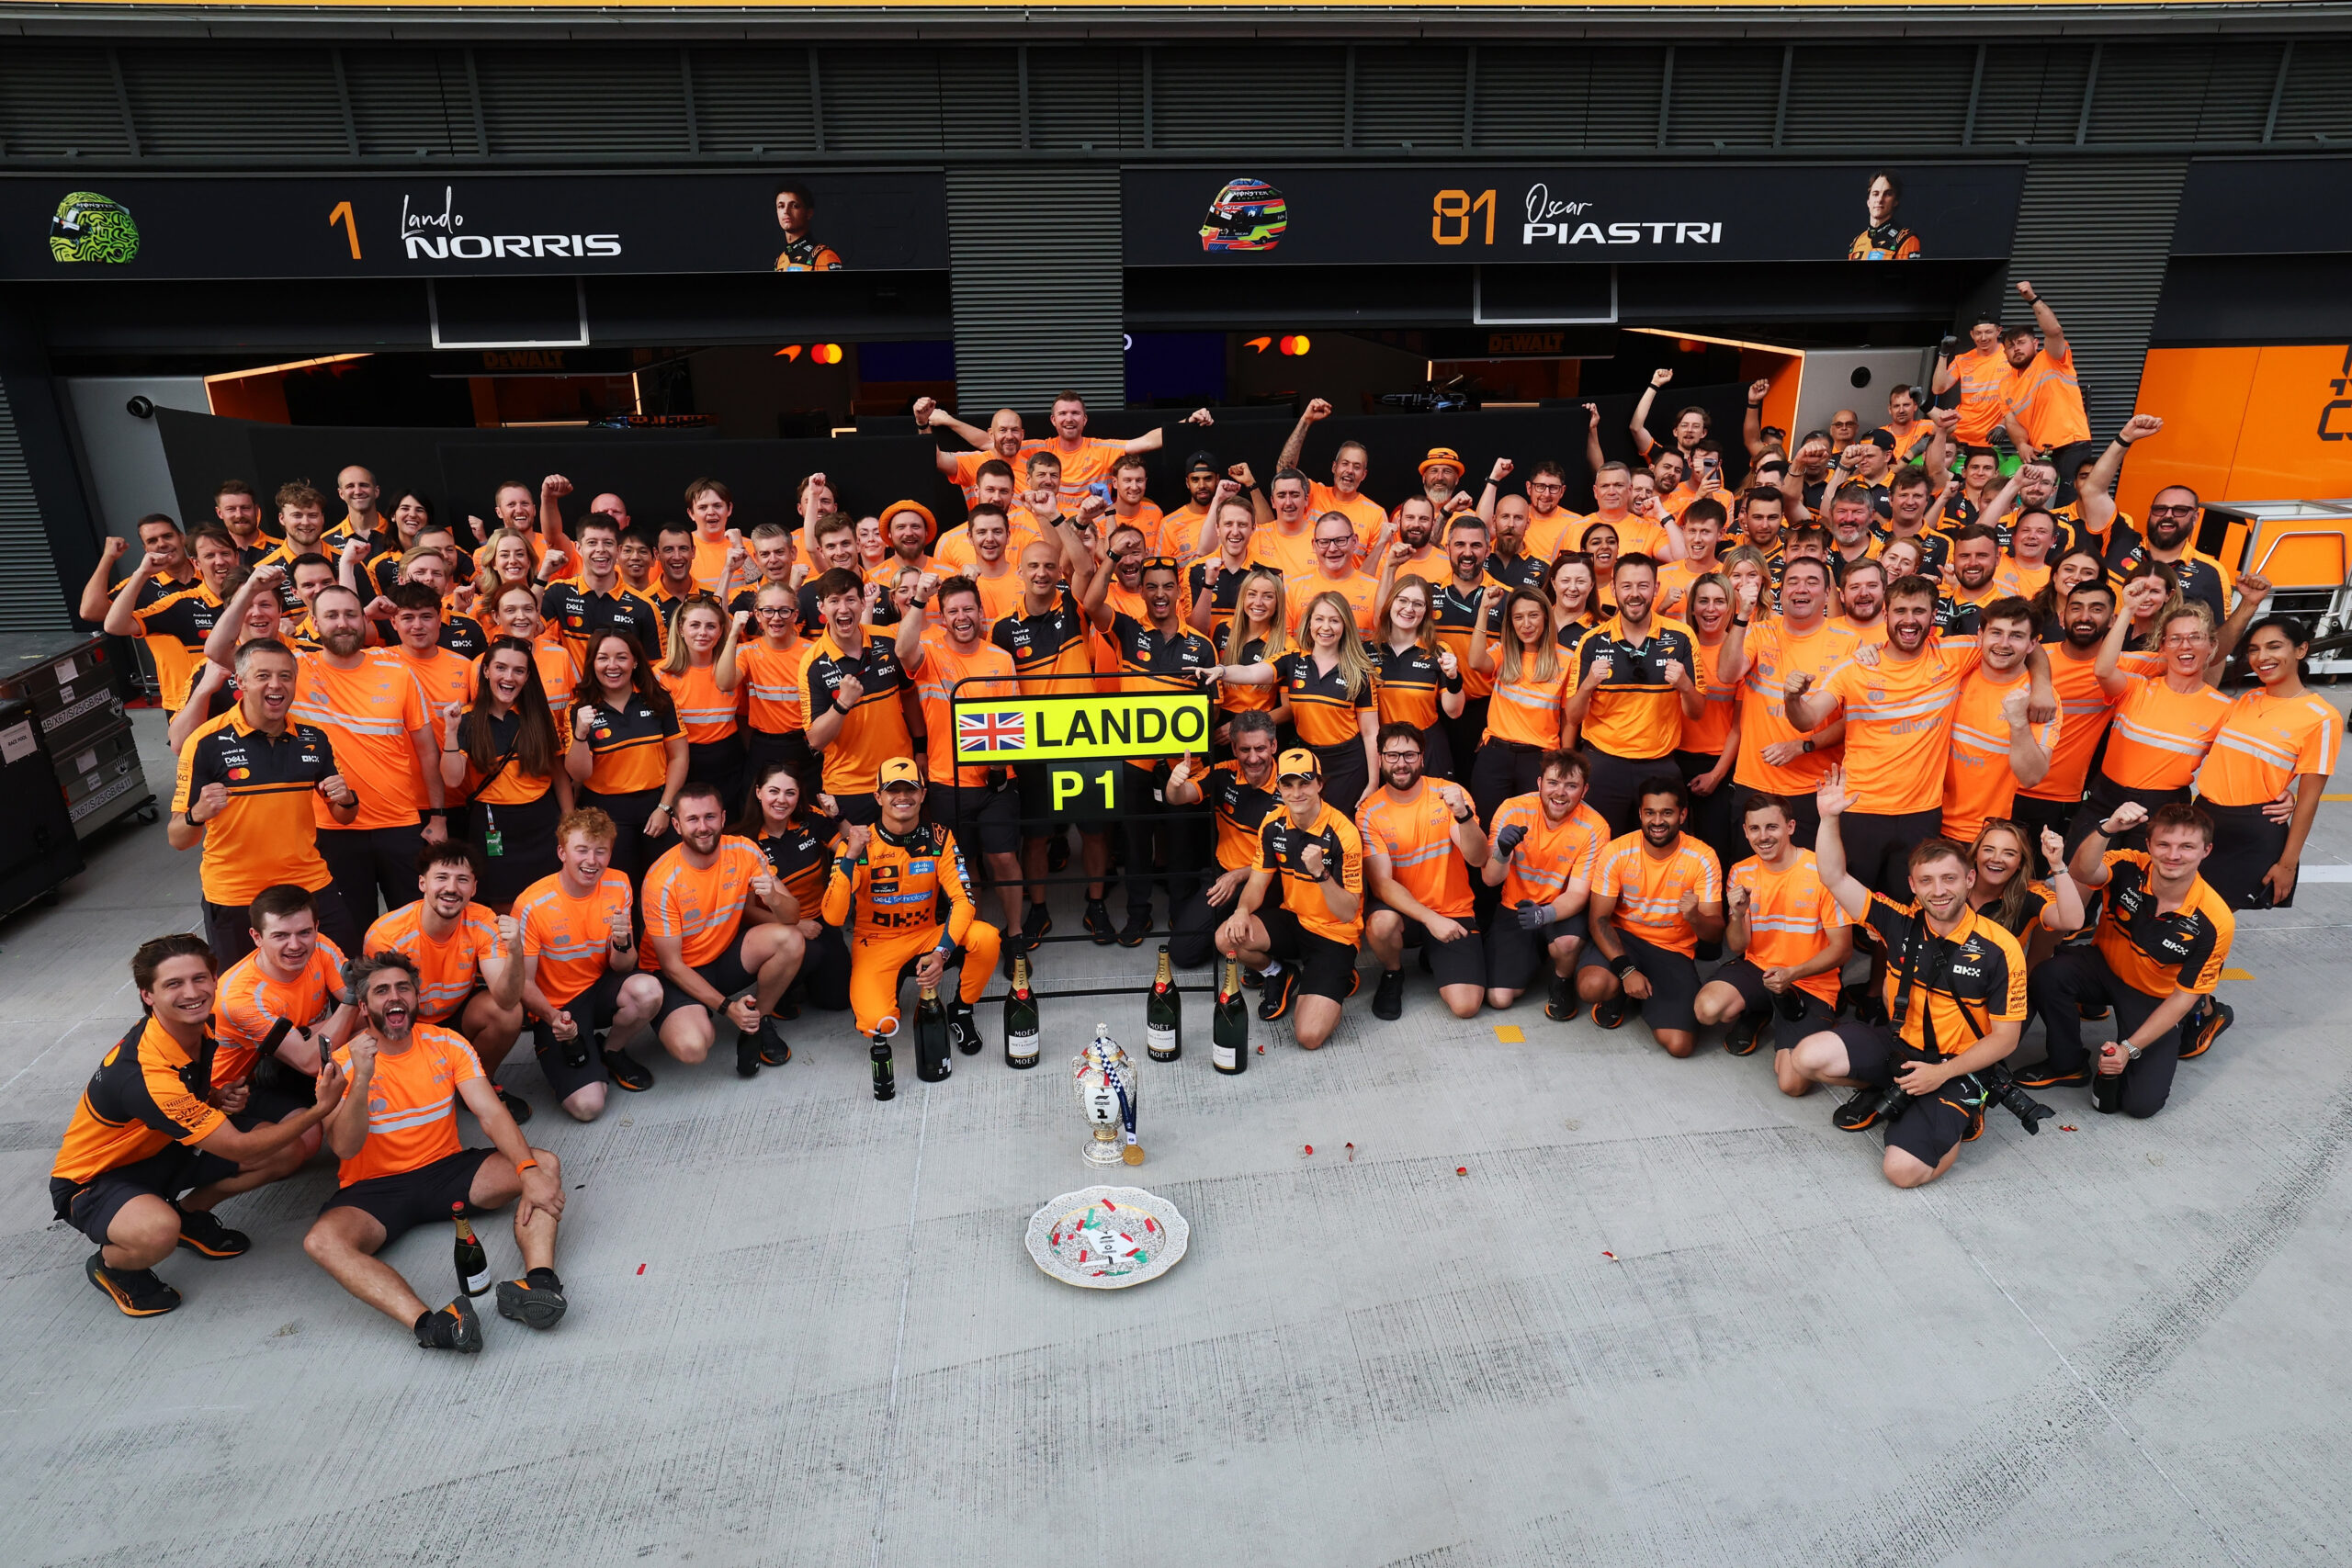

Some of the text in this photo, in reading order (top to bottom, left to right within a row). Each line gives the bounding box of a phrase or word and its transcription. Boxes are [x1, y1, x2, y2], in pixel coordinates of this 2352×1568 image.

[1524, 183, 1593, 224] Oscar
[401, 186, 464, 240] Lando
[1431, 189, 1497, 245] 81
[328, 202, 362, 260] 1
[1522, 222, 1723, 244] PIASTRI
[407, 234, 622, 258] NORRIS
[878, 666, 895, 675] OKX
[1036, 706, 1204, 747] LANDO
[1890, 717, 1943, 736] allwyn
[225, 755, 247, 764] DELL
[301, 755, 319, 763] OKX
[69, 778, 131, 822] B/X67/S/25/GB/6411
[798, 838, 816, 851] OKX
[875, 852, 895, 861] Android
[2120, 894, 2138, 910] DELL
[872, 908, 930, 927] OKX
[2163, 939, 2188, 955] OKX
[1953, 965, 1981, 976] OKX
[1014, 1029, 1037, 1038] MOËT
[1149, 1021, 1170, 1031] MOËT
[1015, 1056, 1036, 1066] MOËT
[1149, 1051, 1170, 1059] MOËT
[166, 1096, 191, 1108] Hilton
